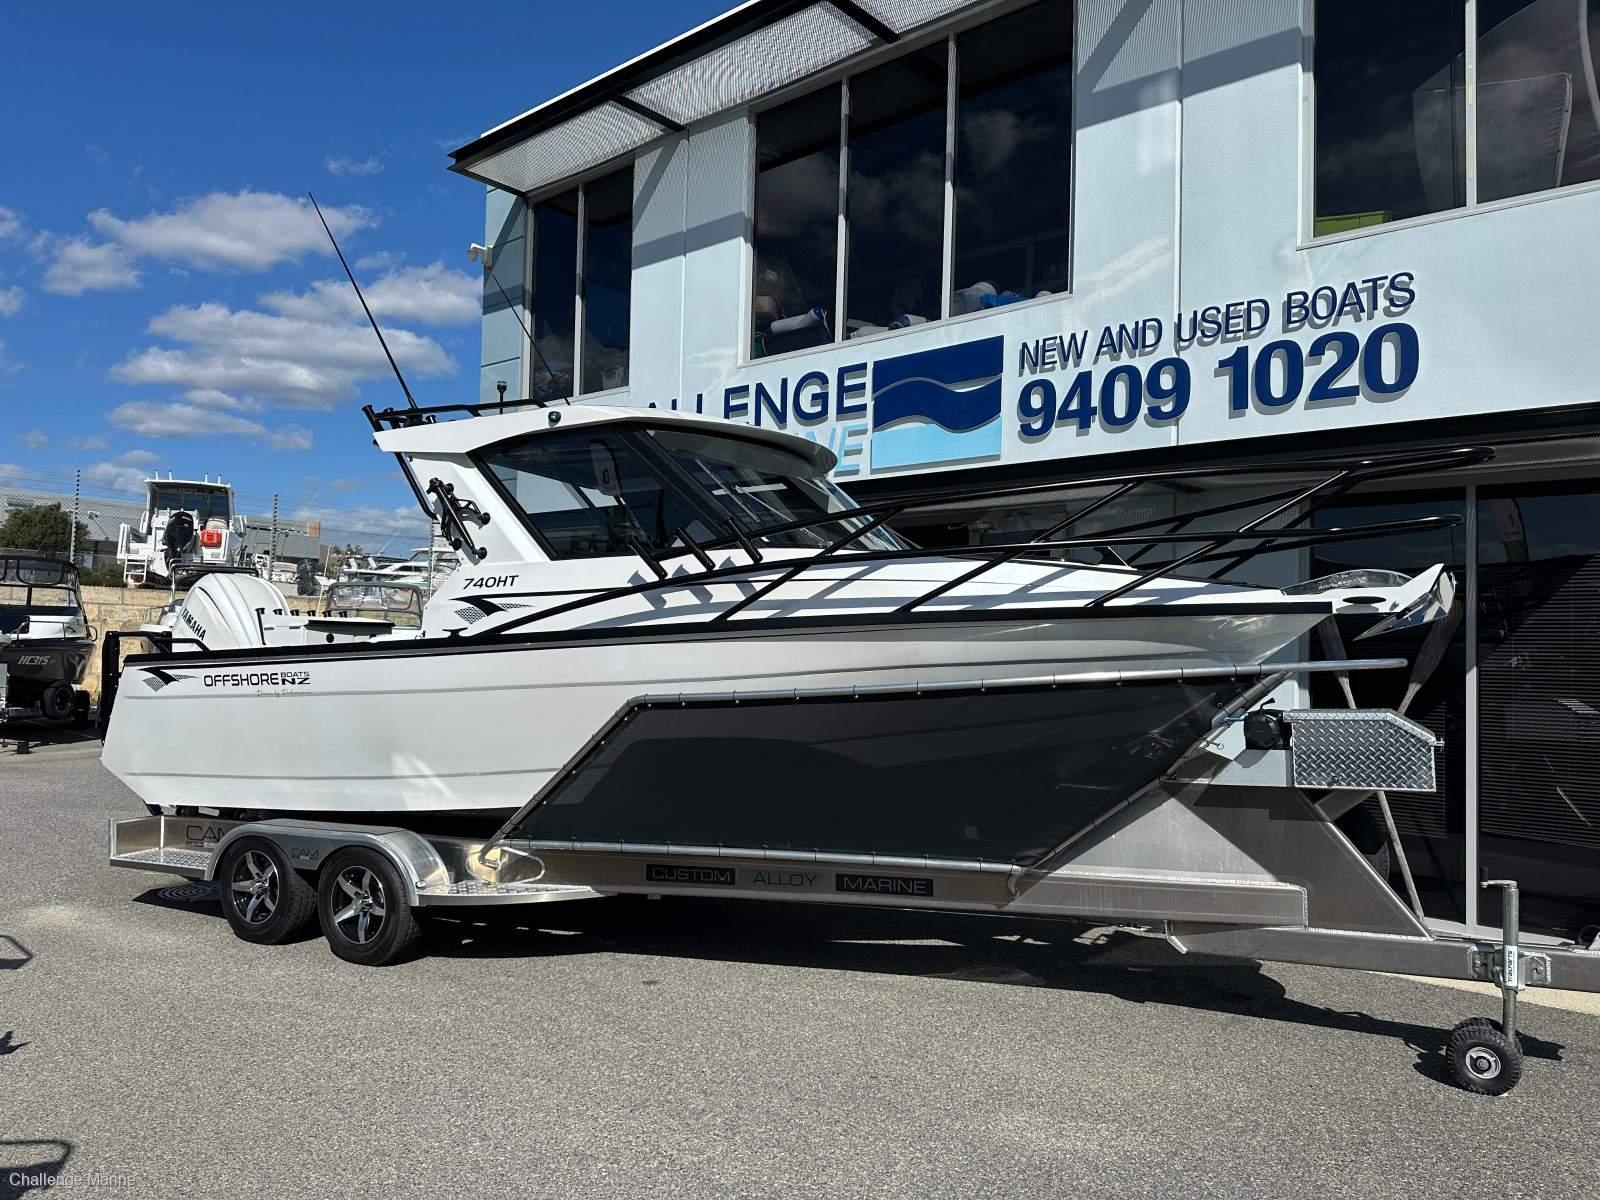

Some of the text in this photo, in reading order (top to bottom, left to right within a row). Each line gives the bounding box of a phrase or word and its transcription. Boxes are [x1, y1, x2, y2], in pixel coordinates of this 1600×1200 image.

[1021, 271, 1416, 370] NEW AND USED BOATS
[1018, 322, 1420, 437] 9409 1020
[181, 608, 206, 641] YAMAHA
[203, 672, 280, 687] OFFSHORE
[281, 677, 311, 685] NZ
[652, 867, 927, 895] CUSTOM ALLOY MARINE
